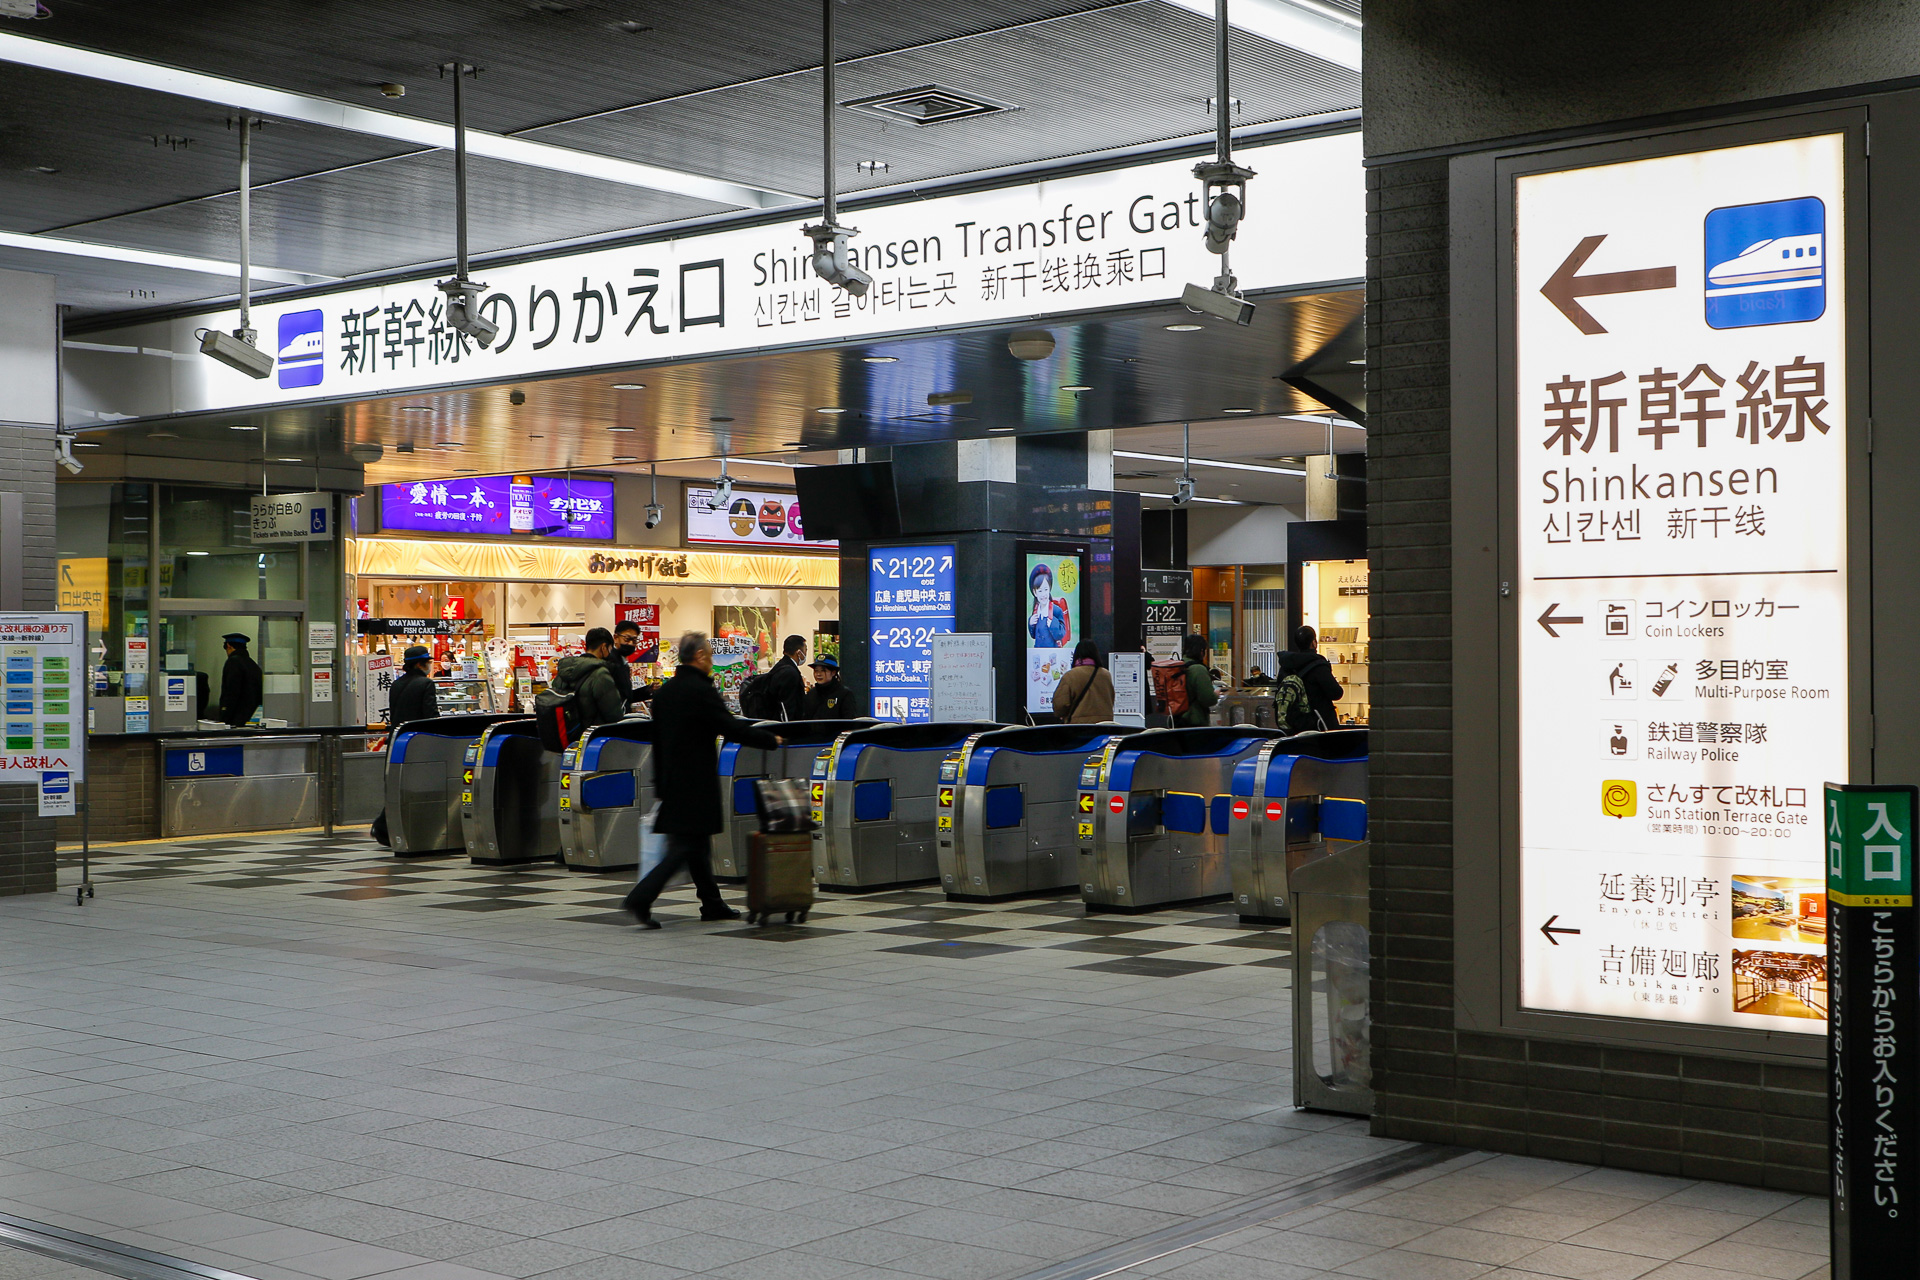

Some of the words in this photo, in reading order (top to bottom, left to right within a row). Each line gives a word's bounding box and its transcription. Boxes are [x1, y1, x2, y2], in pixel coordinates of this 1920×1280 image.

[753, 235, 941, 287] Shinansen
[955, 203, 1113, 258] Transfer
[1129, 191, 1217, 234] Gat
[980, 246, 1166, 301] 新干线换乘口
[754, 287, 820, 328] 신칸센
[1542, 355, 1831, 456] 新幹線
[409, 482, 495, 509] 愛情一本。
[1543, 463, 1778, 504] Shinkansen
[252, 502, 302, 517] うらが白色の
[549, 497, 602, 511] チオビタ
[252, 517, 277, 530] きっぷ
[1543, 508, 1642, 543] 신칸센
[1667, 503, 1767, 540] 新干线
[253, 531, 269, 539] Tickets
[269, 530, 279, 538] with
[294, 529, 308, 537] Backs
[589, 552, 690, 579] おみやげ街道
[882, 604, 908, 612] Hiroshima,
[1645, 598, 1800, 619] コインロッカー
[388, 619, 426, 627] OKAYAMA'S
[1645, 625, 1673, 638] Coin
[1677, 624, 1725, 638] Lockers
[875, 674, 883, 682] for
[1695, 659, 1789, 681] 多目的室
[1695, 685, 1787, 701] Multi-Purpose
[1791, 686, 1830, 699] Room
[1647, 721, 1768, 744] 鉄道警察隊
[1647, 747, 1697, 764] Railway
[1701, 748, 1739, 762] Police
[1646, 783, 1807, 808] さんすて改札口
[1647, 806, 1671, 819] Sun
[1674, 807, 1720, 822] Station
[1723, 808, 1772, 823] Terrace
[1776, 811, 1808, 825] Gate
[1829, 799, 1843, 879] 入口
[1861, 802, 1904, 882] 入口
[1598, 873, 1720, 907] 延養別亭
[1863, 896, 1900, 905] Gate
[1599, 944, 1720, 981] 吉備廻廊
[1599, 975, 1720, 994] Kibikairo
[1832, 906, 1845, 1212] こちらからお入りください。
[1871, 911, 1899, 1219] こちらからお入りください。
